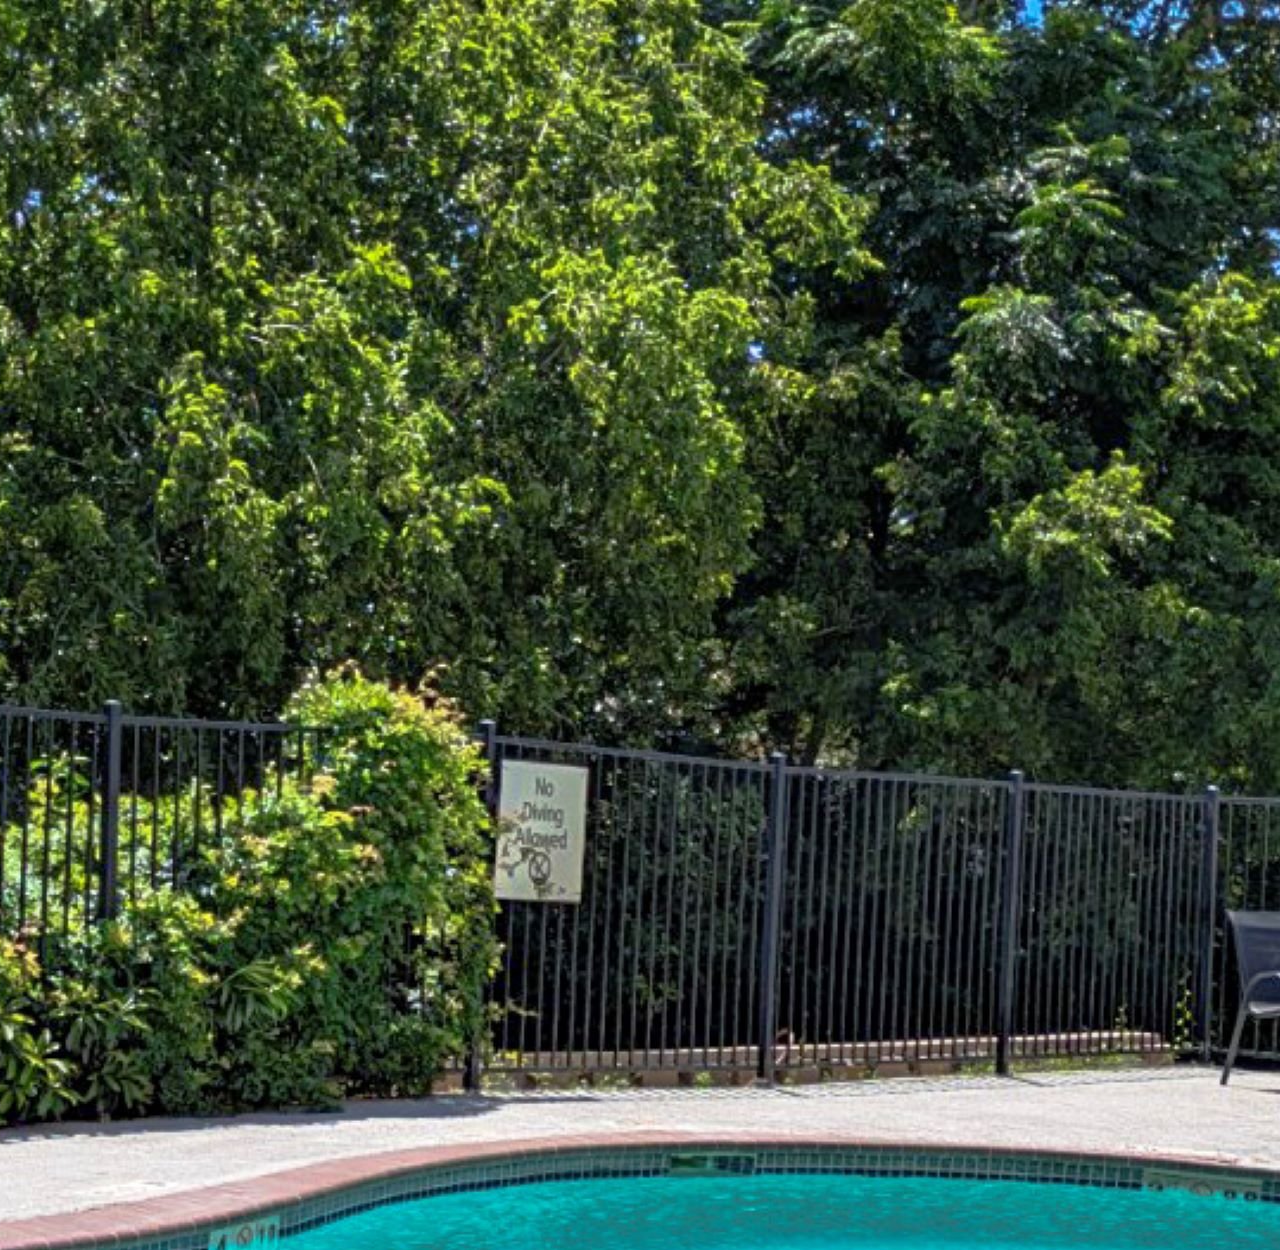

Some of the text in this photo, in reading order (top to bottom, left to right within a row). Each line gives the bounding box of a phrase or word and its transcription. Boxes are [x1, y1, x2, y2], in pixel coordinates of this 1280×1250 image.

[535, 777, 553, 796] No
[523, 802, 565, 828] Diving
[514, 828, 568, 850] Allowed
